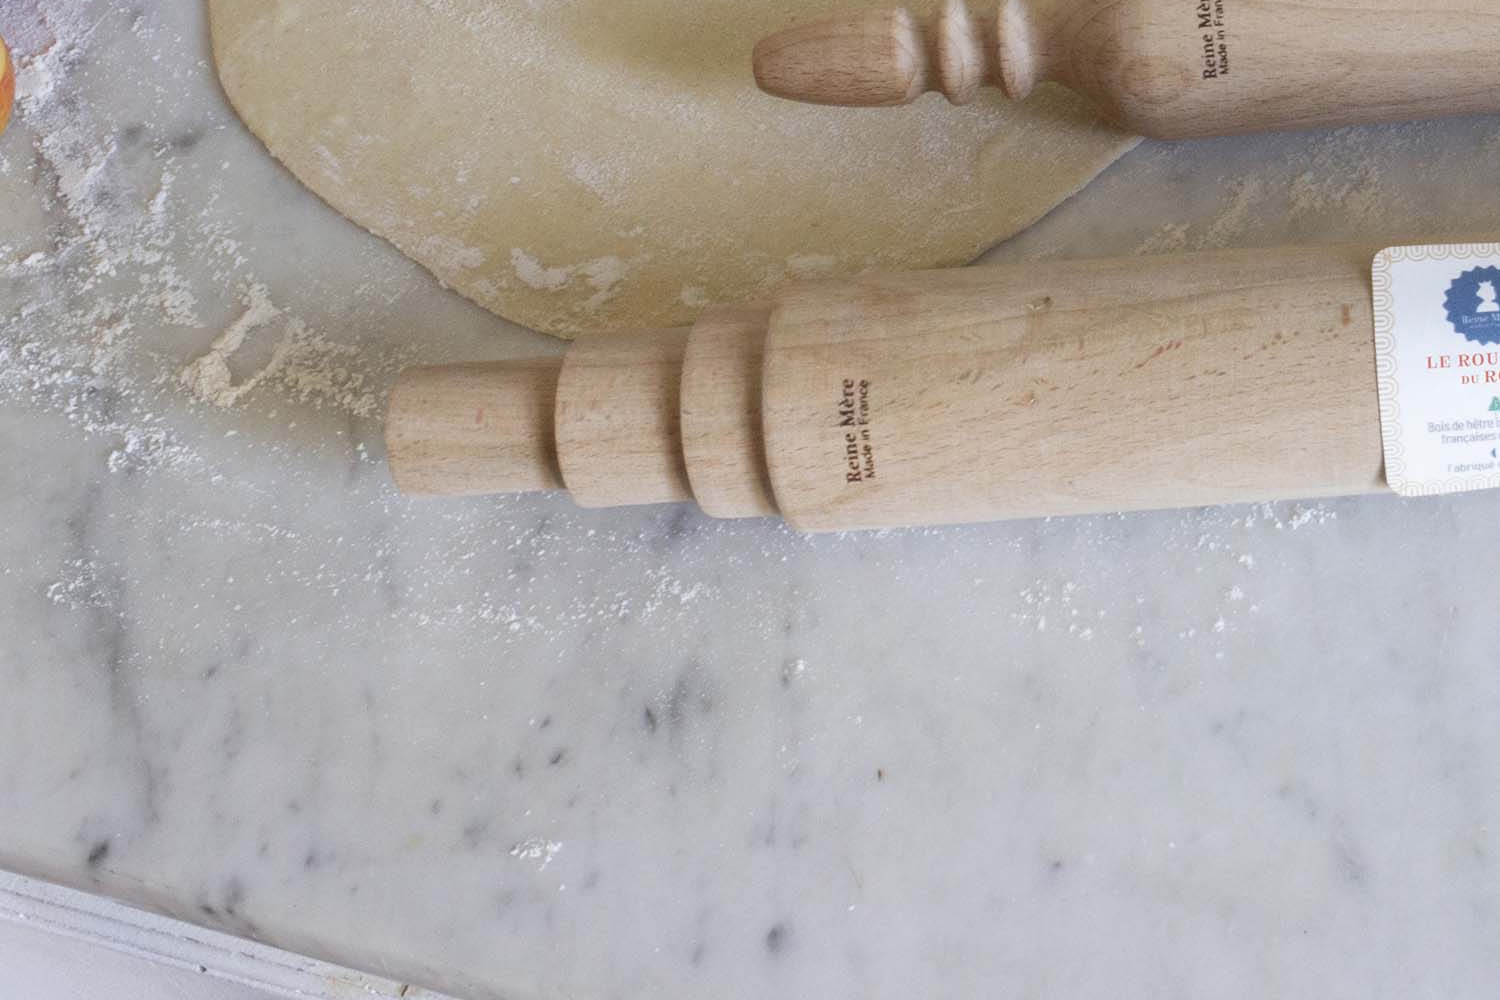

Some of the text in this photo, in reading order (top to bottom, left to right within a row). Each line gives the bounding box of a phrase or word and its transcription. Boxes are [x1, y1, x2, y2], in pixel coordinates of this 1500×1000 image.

[1216, 30, 1225, 40] in
[1201, 34, 1217, 80] Reine
[1217, 43, 1229, 75] Made
[1426, 355, 1451, 369] LE
[1461, 375, 1479, 385] DU
[839, 378, 862, 483] Reine Mère
[858, 379, 876, 478] Made in France
[1427, 421, 1450, 433] Bois
[1451, 419, 1464, 431] de
[1441, 431, 1497, 445] françaises
